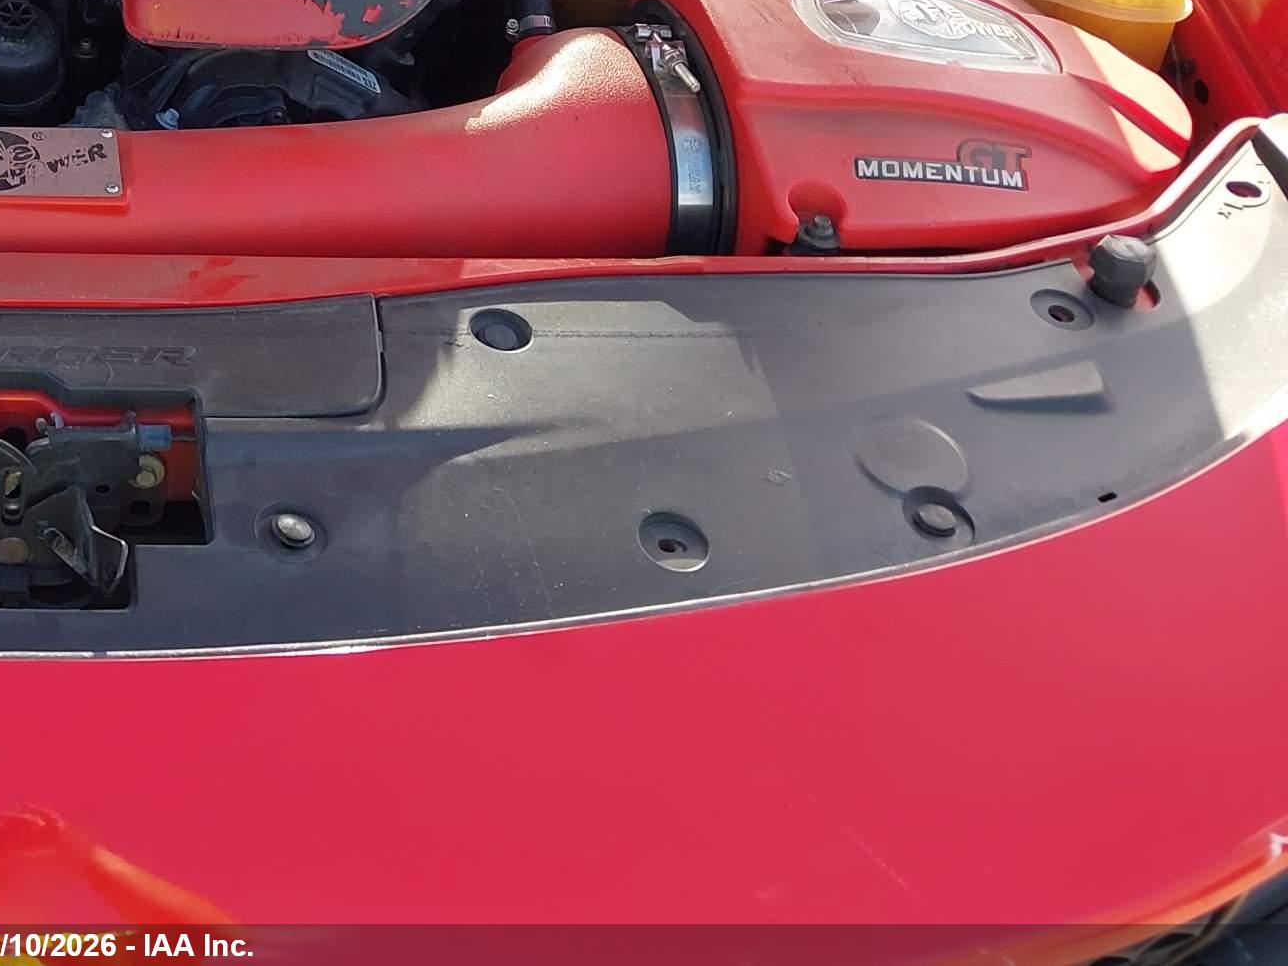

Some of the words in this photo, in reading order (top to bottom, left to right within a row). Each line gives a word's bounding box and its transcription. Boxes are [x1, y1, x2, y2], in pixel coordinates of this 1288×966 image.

[10, 143, 107, 181] PWER
[857, 158, 1023, 188] MOMENTUM
[959, 139, 1028, 173] GT
